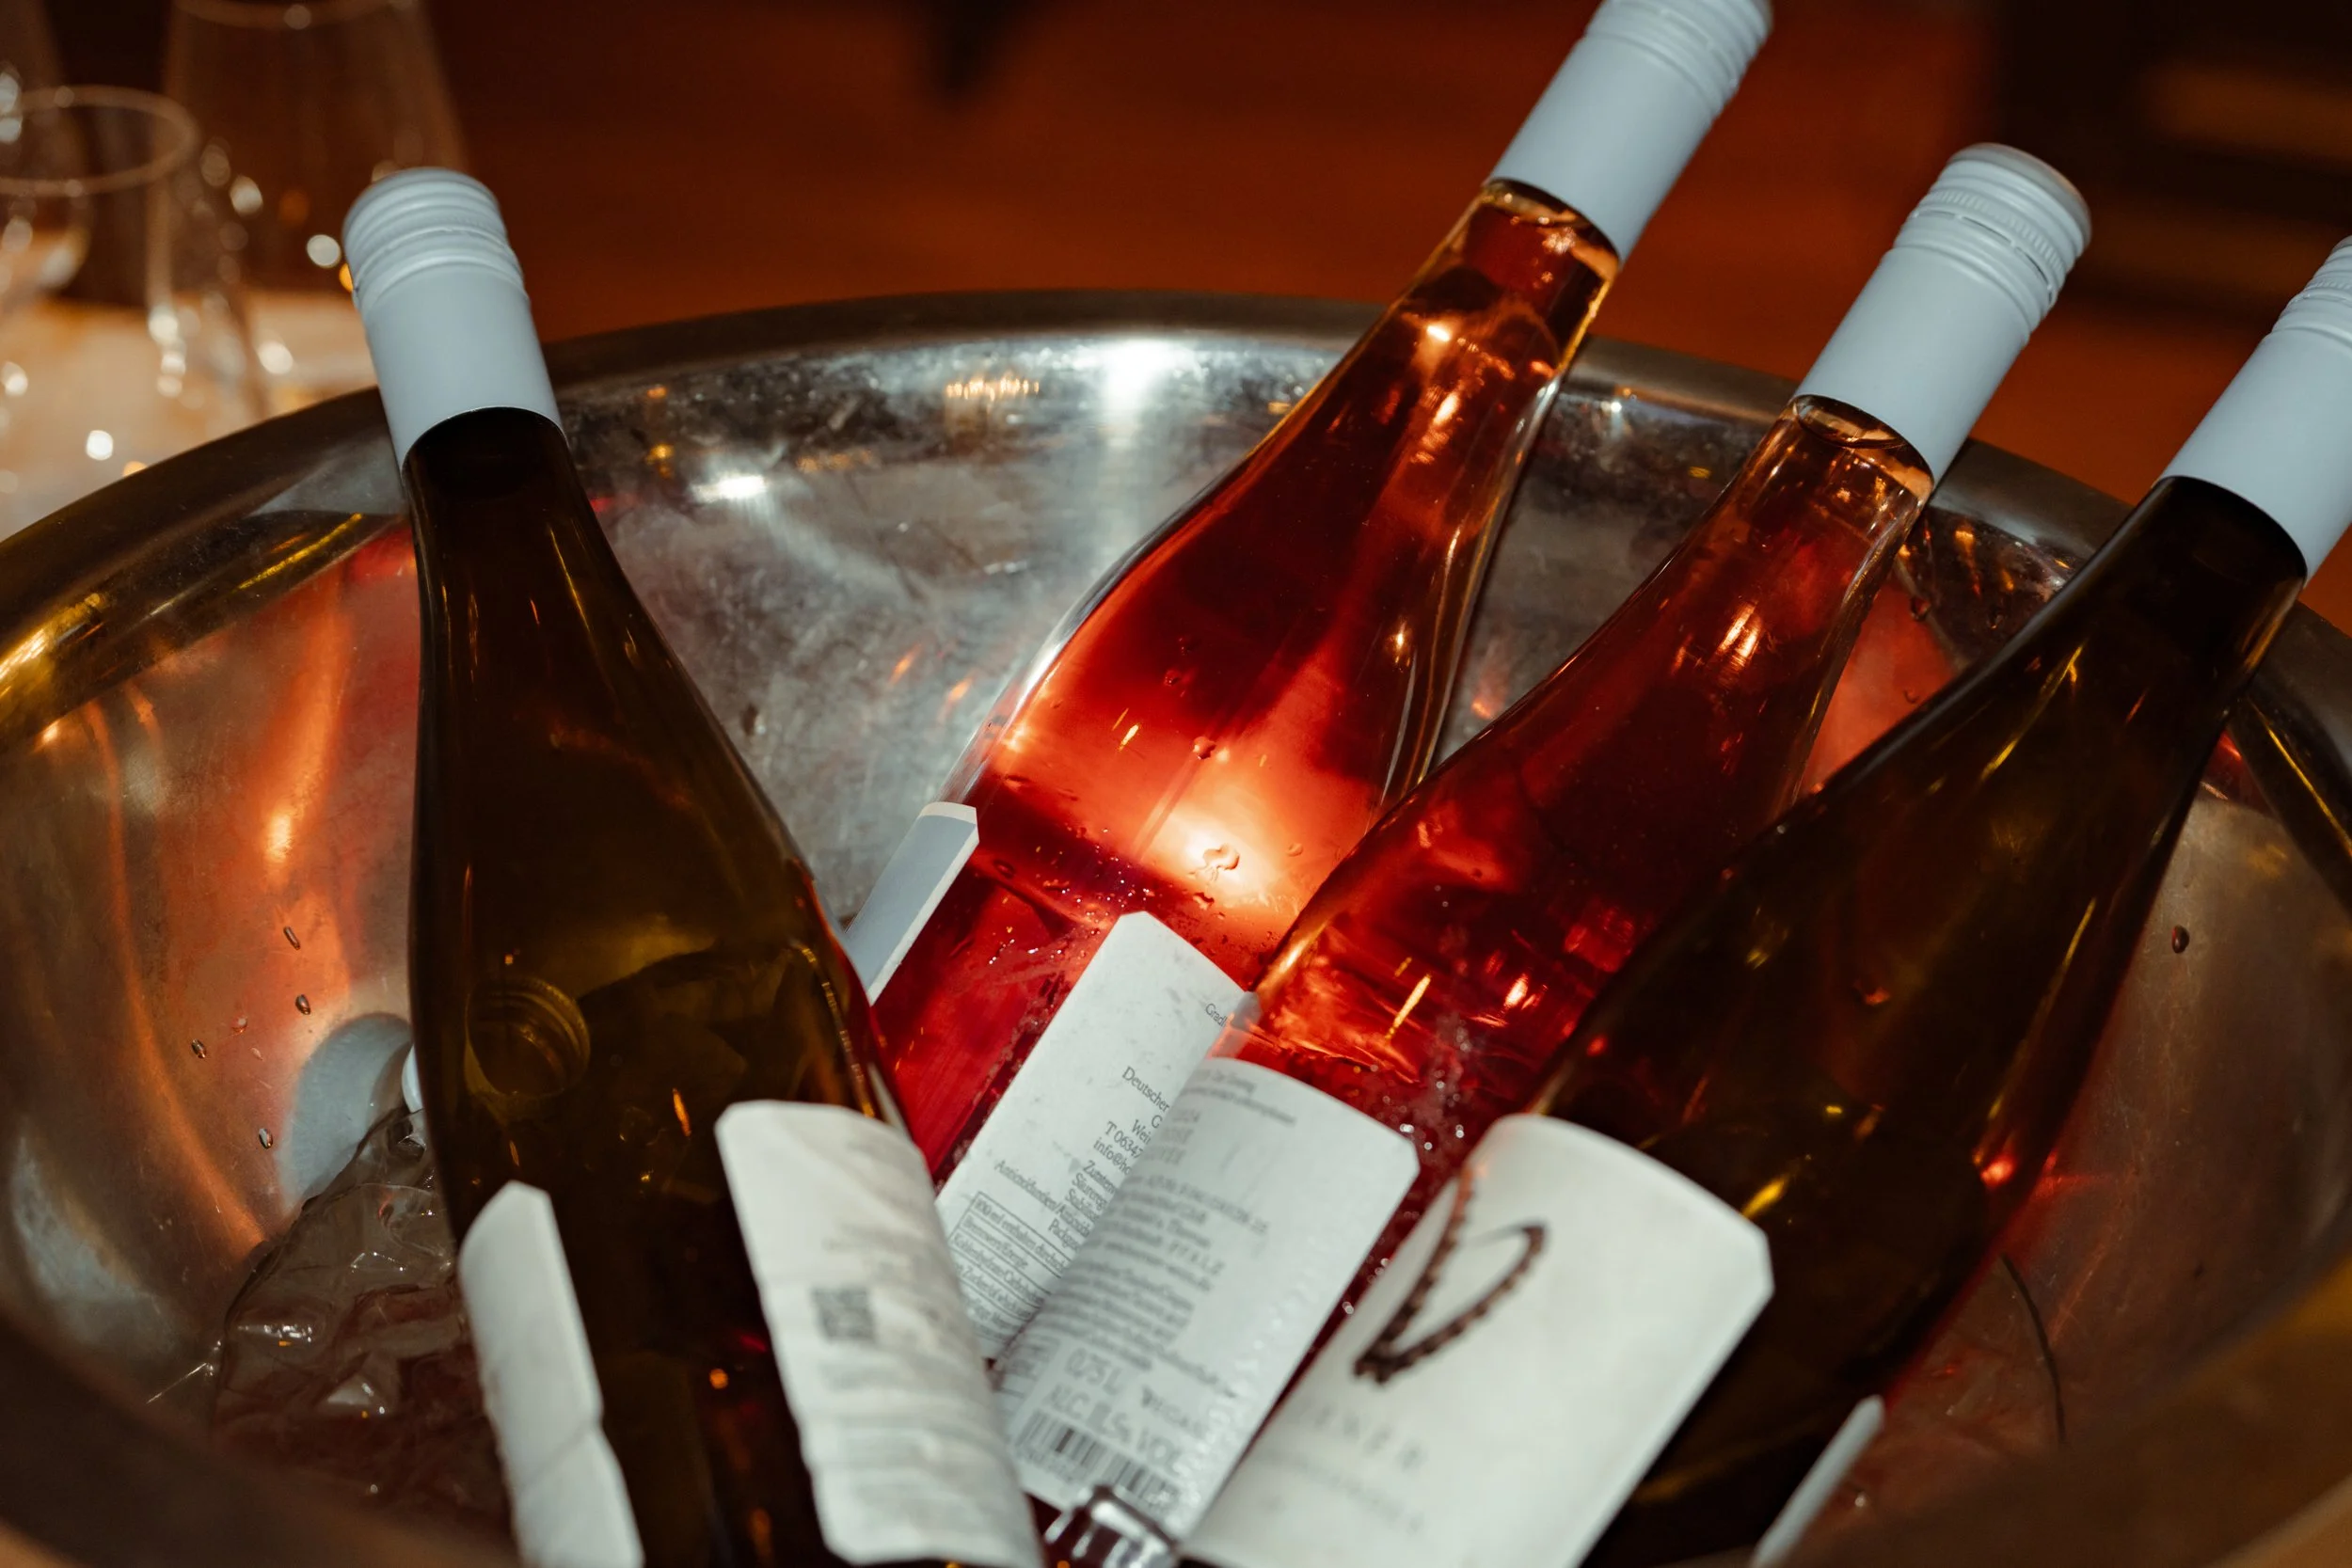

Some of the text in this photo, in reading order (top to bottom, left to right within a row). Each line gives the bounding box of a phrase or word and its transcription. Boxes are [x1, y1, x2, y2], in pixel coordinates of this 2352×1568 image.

[1121, 1066, 1170, 1113] Deutscher
[1104, 1120, 1117, 1135] T
[1114, 1129, 1144, 1159] 06347
